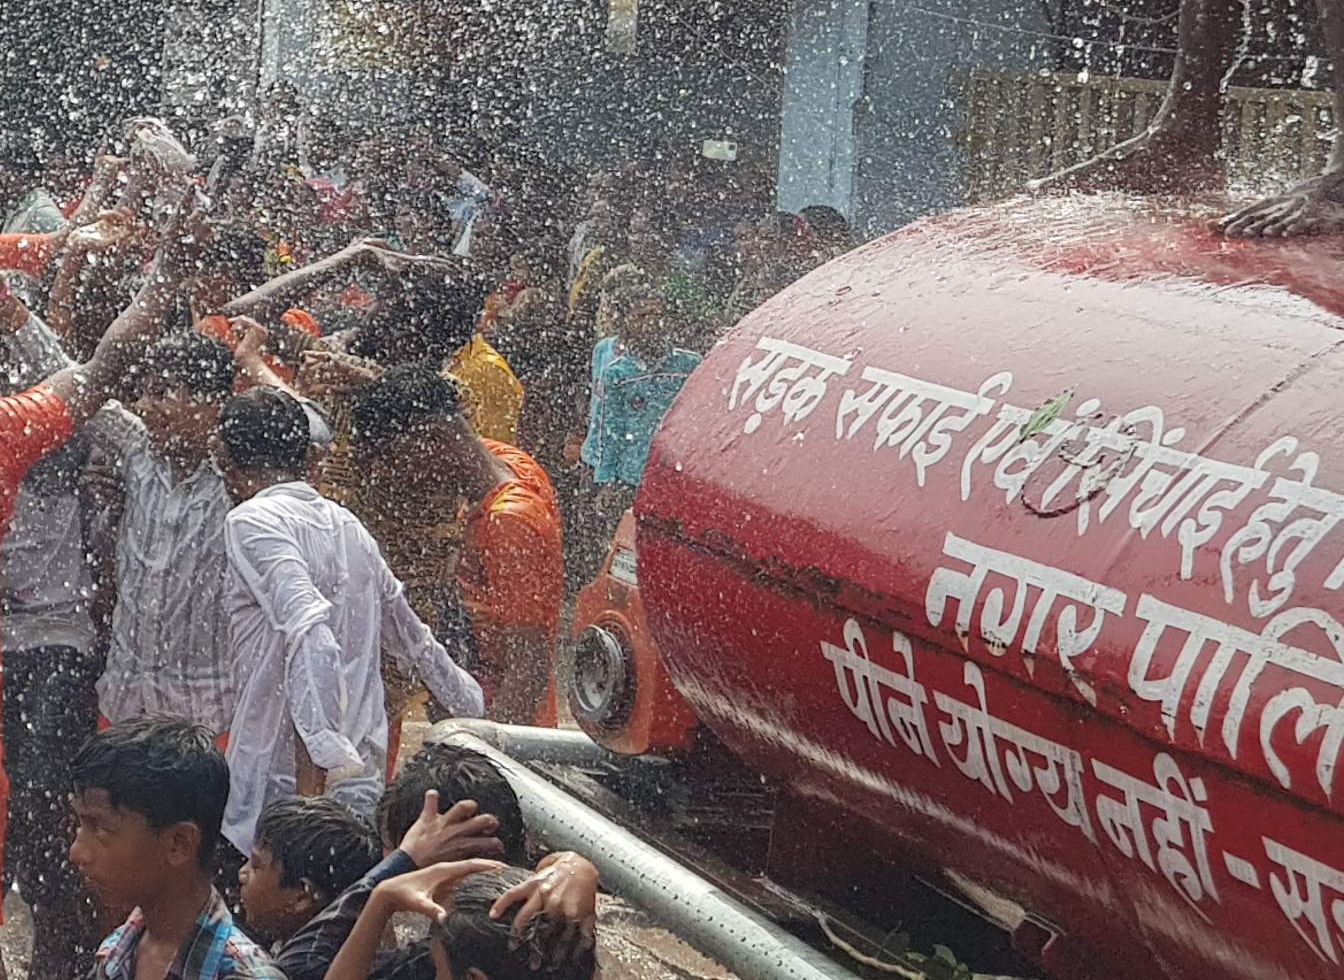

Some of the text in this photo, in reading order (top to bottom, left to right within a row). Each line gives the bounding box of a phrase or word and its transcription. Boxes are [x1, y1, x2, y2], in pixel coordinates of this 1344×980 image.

[730, 337, 851, 434] सड़क
[835, 366, 1013, 487] सफाई
[924, 532, 1128, 707] नगर
[819, 618, 942, 768] पीने
[933, 661, 1099, 847] योग्य
[1091, 752, 1221, 925] नहीं
